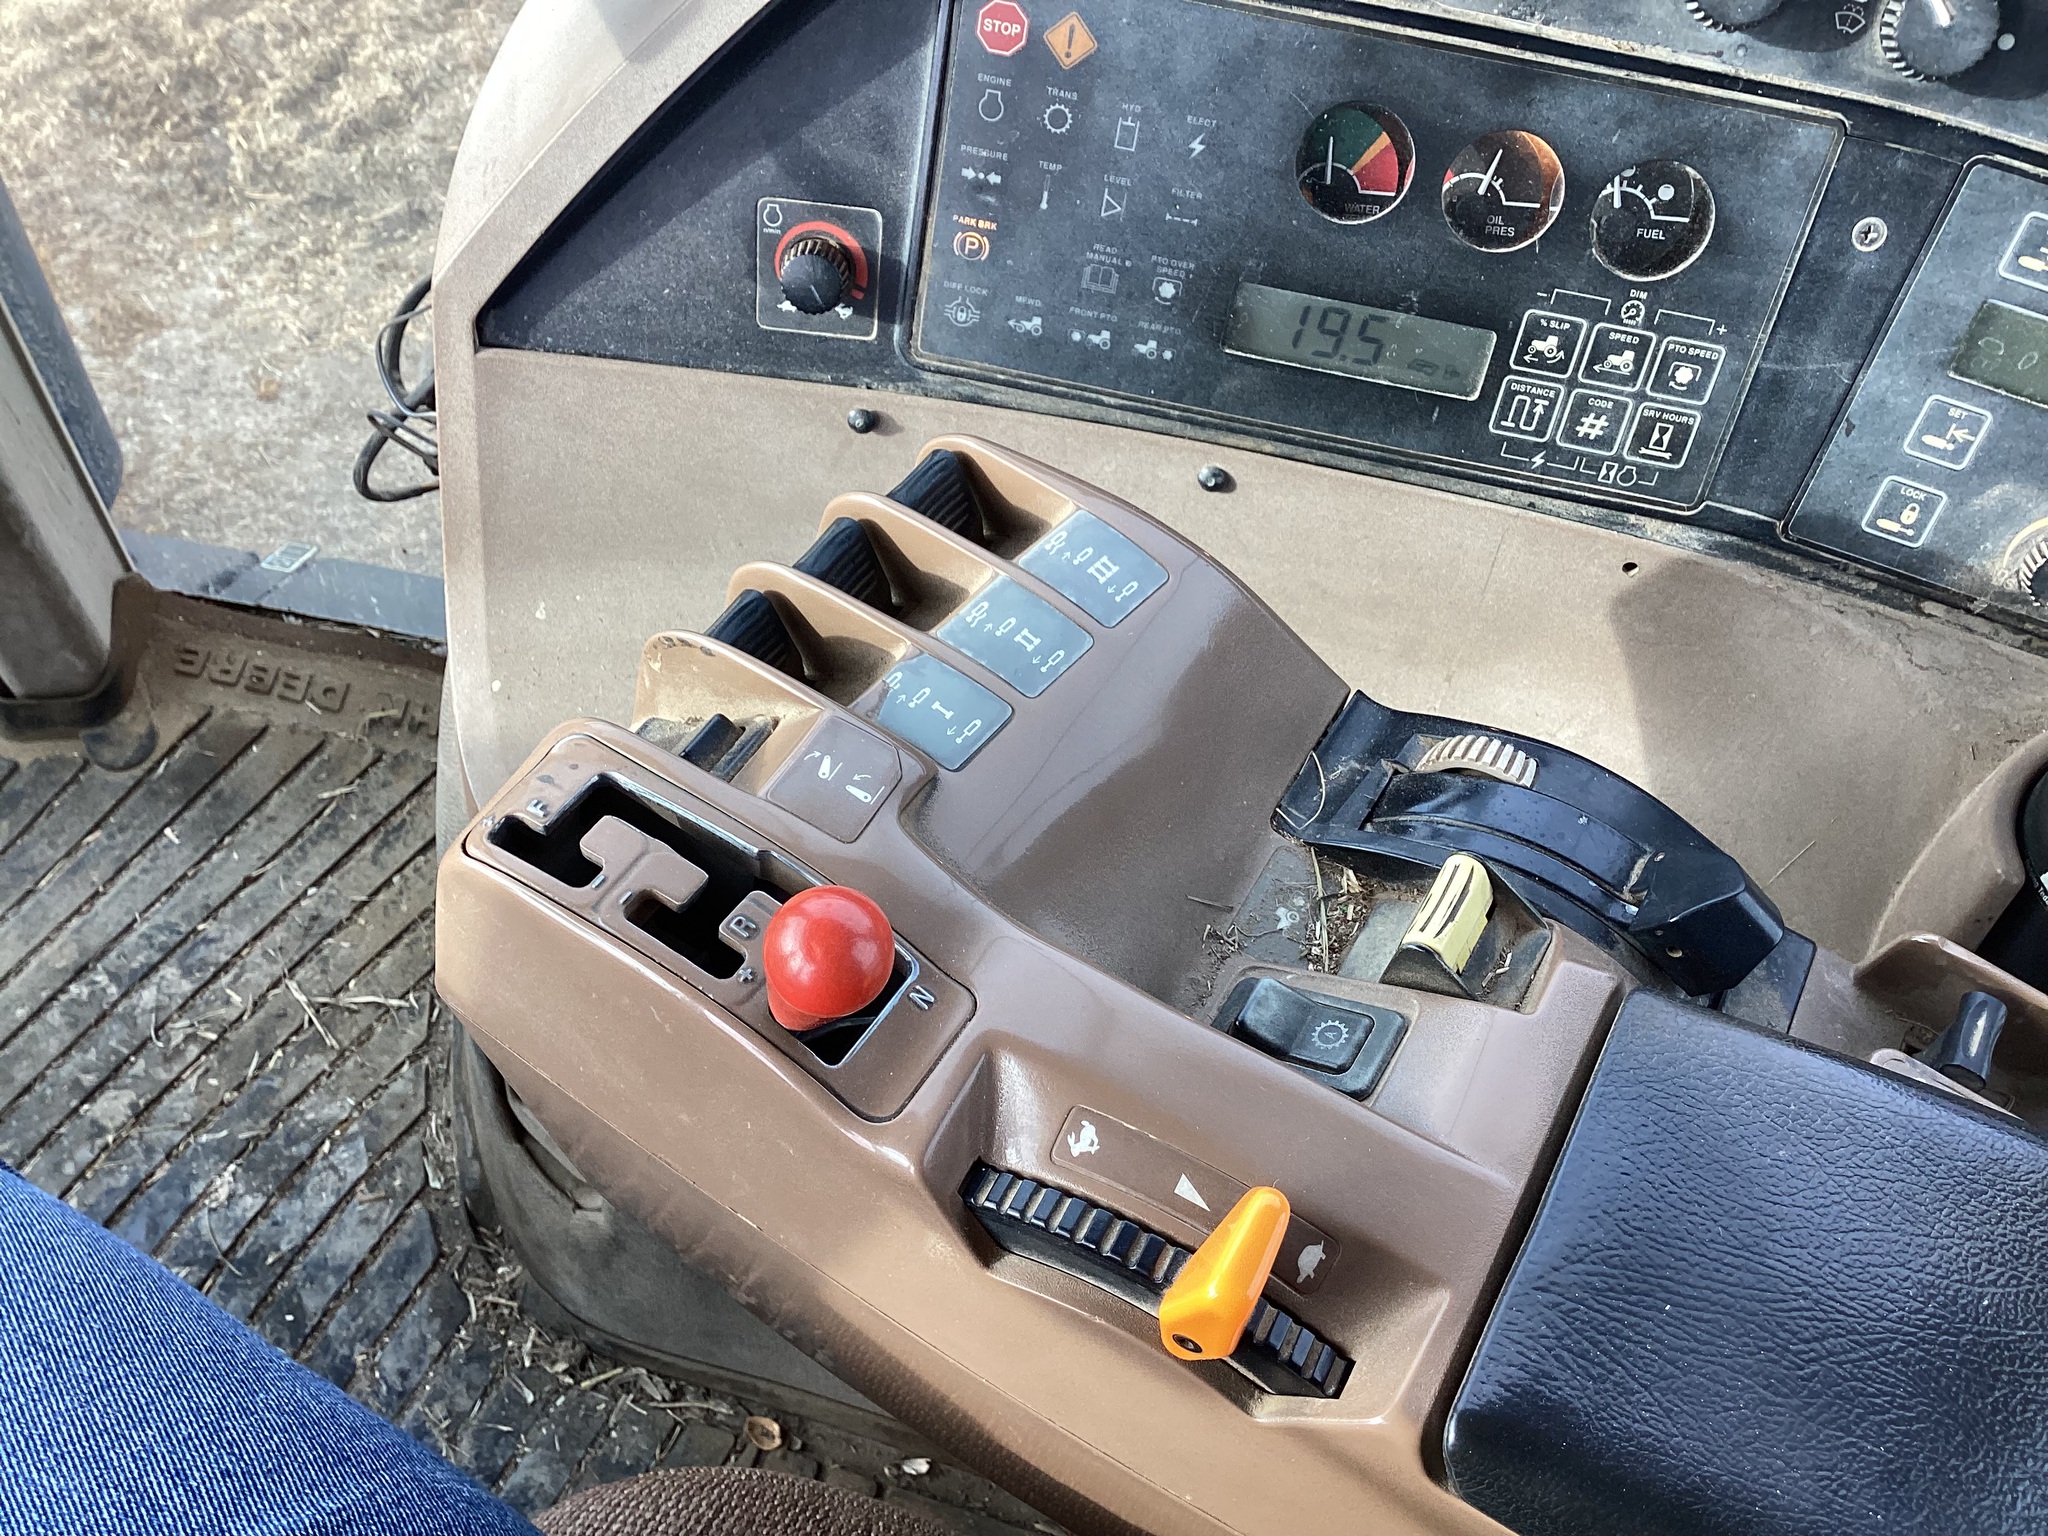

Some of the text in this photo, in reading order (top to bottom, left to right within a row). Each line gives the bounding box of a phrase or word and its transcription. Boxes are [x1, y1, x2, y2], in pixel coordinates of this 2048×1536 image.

[983, 18, 1021, 37] STOP
[977, 73, 1012, 87] ENGINE
[1046, 86, 1078, 100] TRANS
[1121, 102, 1141, 113] HYD
[1187, 115, 1217, 127] ELECT
[960, 144, 1008, 161] PRESSURE
[1039, 160, 1063, 171] TEMP
[1104, 174, 1132, 186] LEVEL
[1171, 187, 1203, 200] FILTER
[1344, 203, 1380, 214] WATER
[953, 214, 998, 231] PARK BRK
[1486, 215, 1505, 225] OIL
[1485, 225, 1515, 237] PRES
[1636, 228, 1666, 240] FUEL
[964, 236, 980, 255] P
[1093, 243, 1118, 254] READ
[1086, 252, 1122, 265] MANUAL
[1151, 255, 1196, 271] PTO OVER
[1157, 266, 1186, 279] SPEED
[943, 280, 988, 296] DIFF LOCK
[1630, 289, 1648, 300] DIM
[1069, 306, 1118, 322] FRONT PTO
[1540, 319, 1571, 331] % SLIP
[1291, 304, 1390, 367] 19.5
[1608, 331, 1640, 345] SPEED
[1667, 343, 1719, 361] PTO SPEED
[1510, 382, 1556, 398] DISTANCE
[1587, 397, 1614, 410] CODE
[1642, 409, 1695, 425] SRV HOURS
[1947, 407, 1968, 420] SET
[1900, 486, 1927, 501] LOCK
[174, 648, 351, 713] DEERE
[526, 799, 546, 818] F
[729, 916, 756, 938] R
[909, 985, 935, 1010] N
